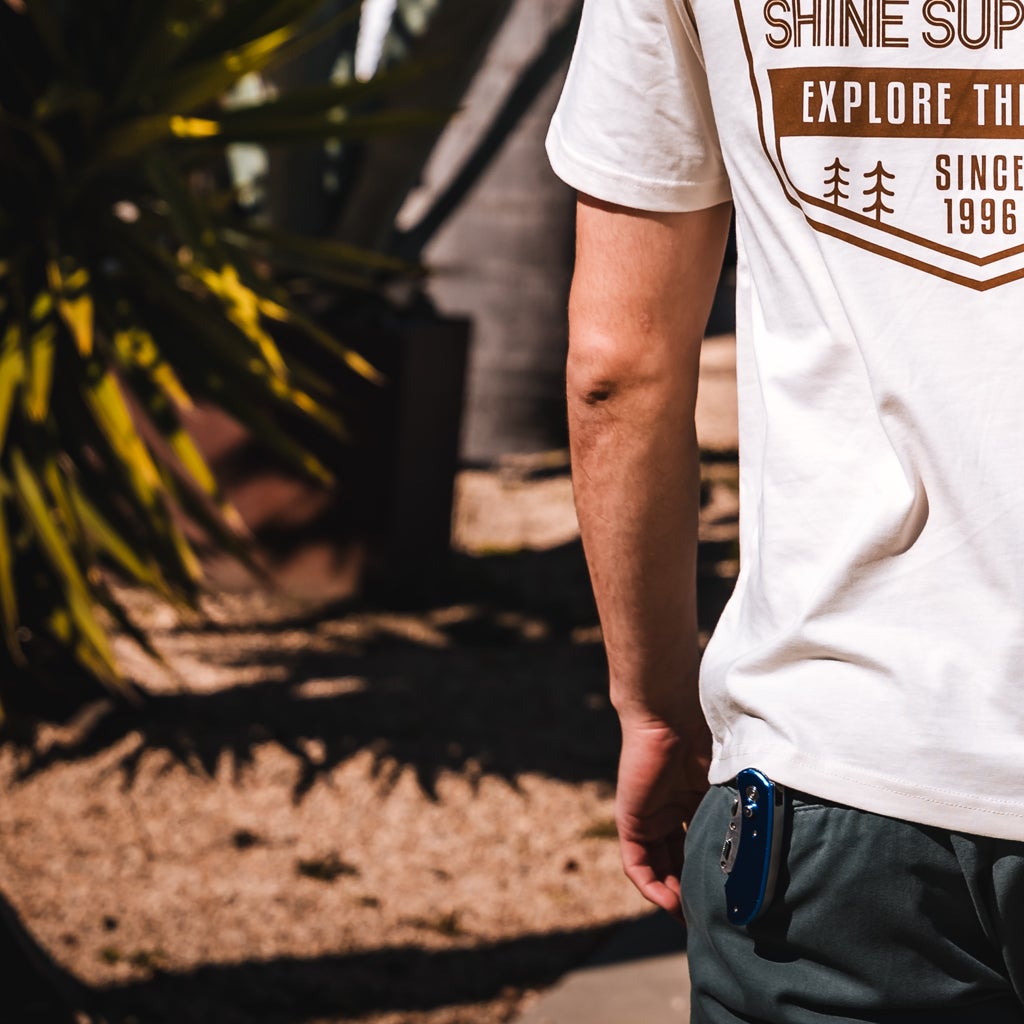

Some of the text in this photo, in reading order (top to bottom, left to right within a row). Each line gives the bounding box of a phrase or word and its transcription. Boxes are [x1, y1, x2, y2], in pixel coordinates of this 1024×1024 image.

[802, 80, 951, 125] EXPLORE
[935, 153, 1024, 192] SINCE
[943, 197, 1017, 235] 1996
